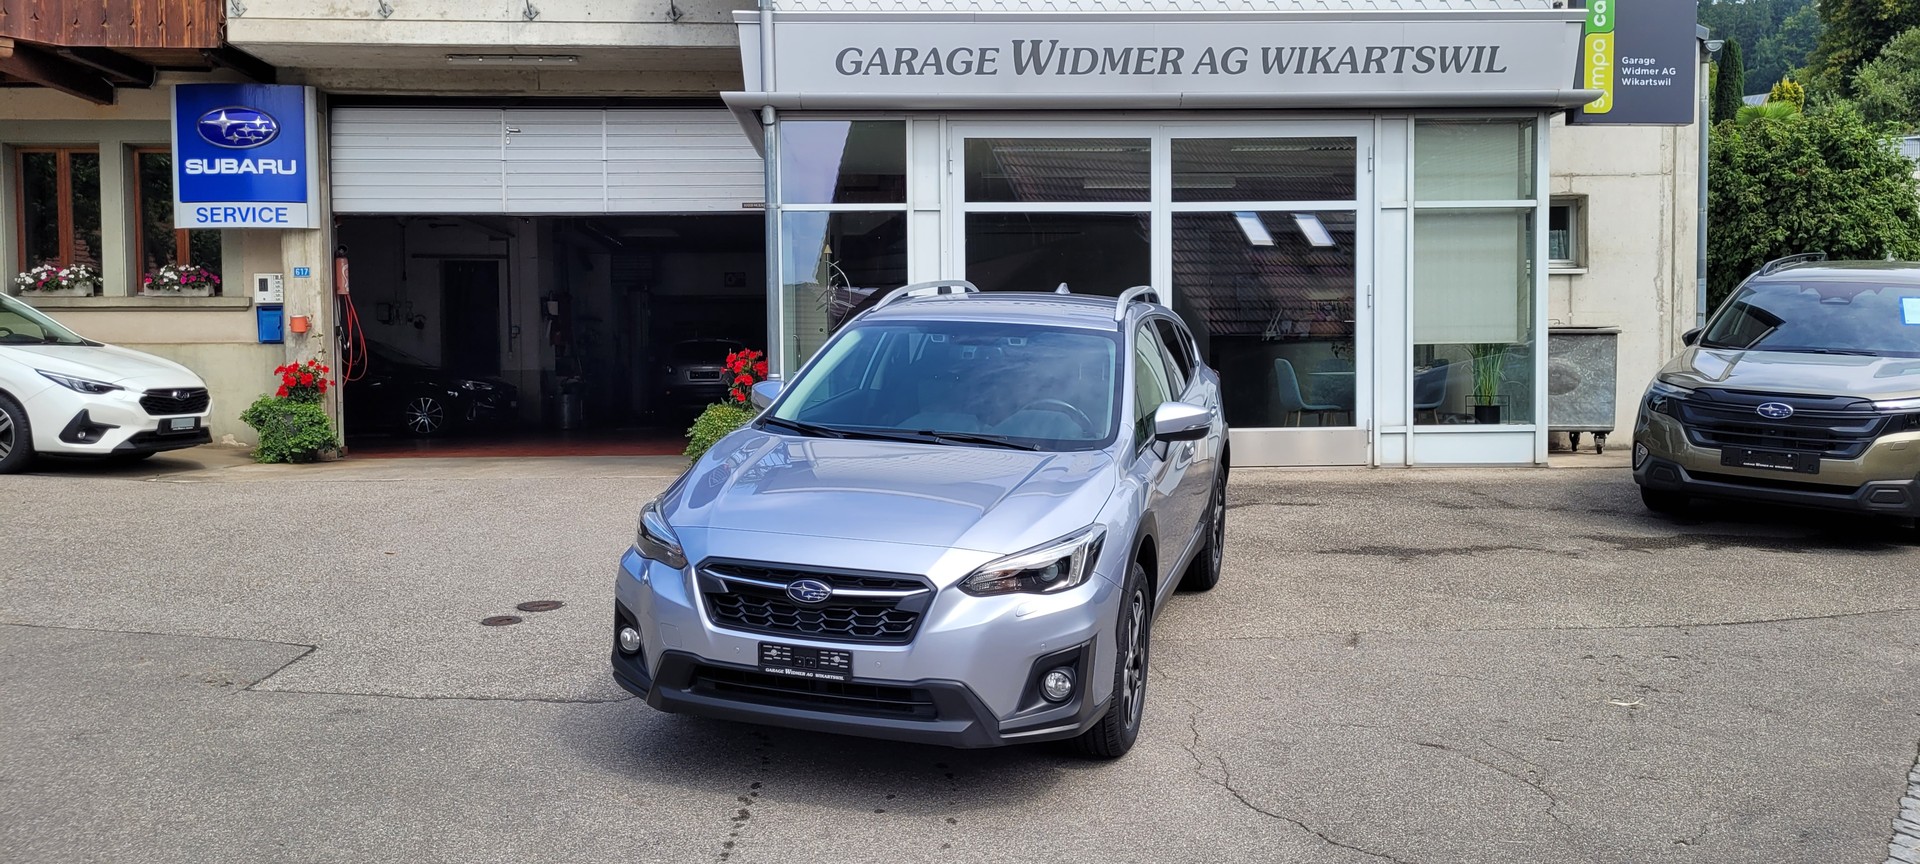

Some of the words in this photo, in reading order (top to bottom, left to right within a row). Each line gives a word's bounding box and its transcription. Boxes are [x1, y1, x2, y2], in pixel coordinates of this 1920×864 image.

[835, 47, 1000, 76] GARAGE
[1011, 39, 1185, 75] WIDMER
[1191, 46, 1249, 75] AG
[1261, 45, 1507, 74] WIKARTSWIL
[1621, 56, 1656, 66] Garage
[1621, 67, 1660, 76] Widmer
[1661, 67, 1677, 76] AG
[1621, 77, 1672, 86] Wikartswil
[185, 158, 297, 175] SUBARU
[196, 206, 289, 223] SERVICE
[295, 268, 309, 276] 617
